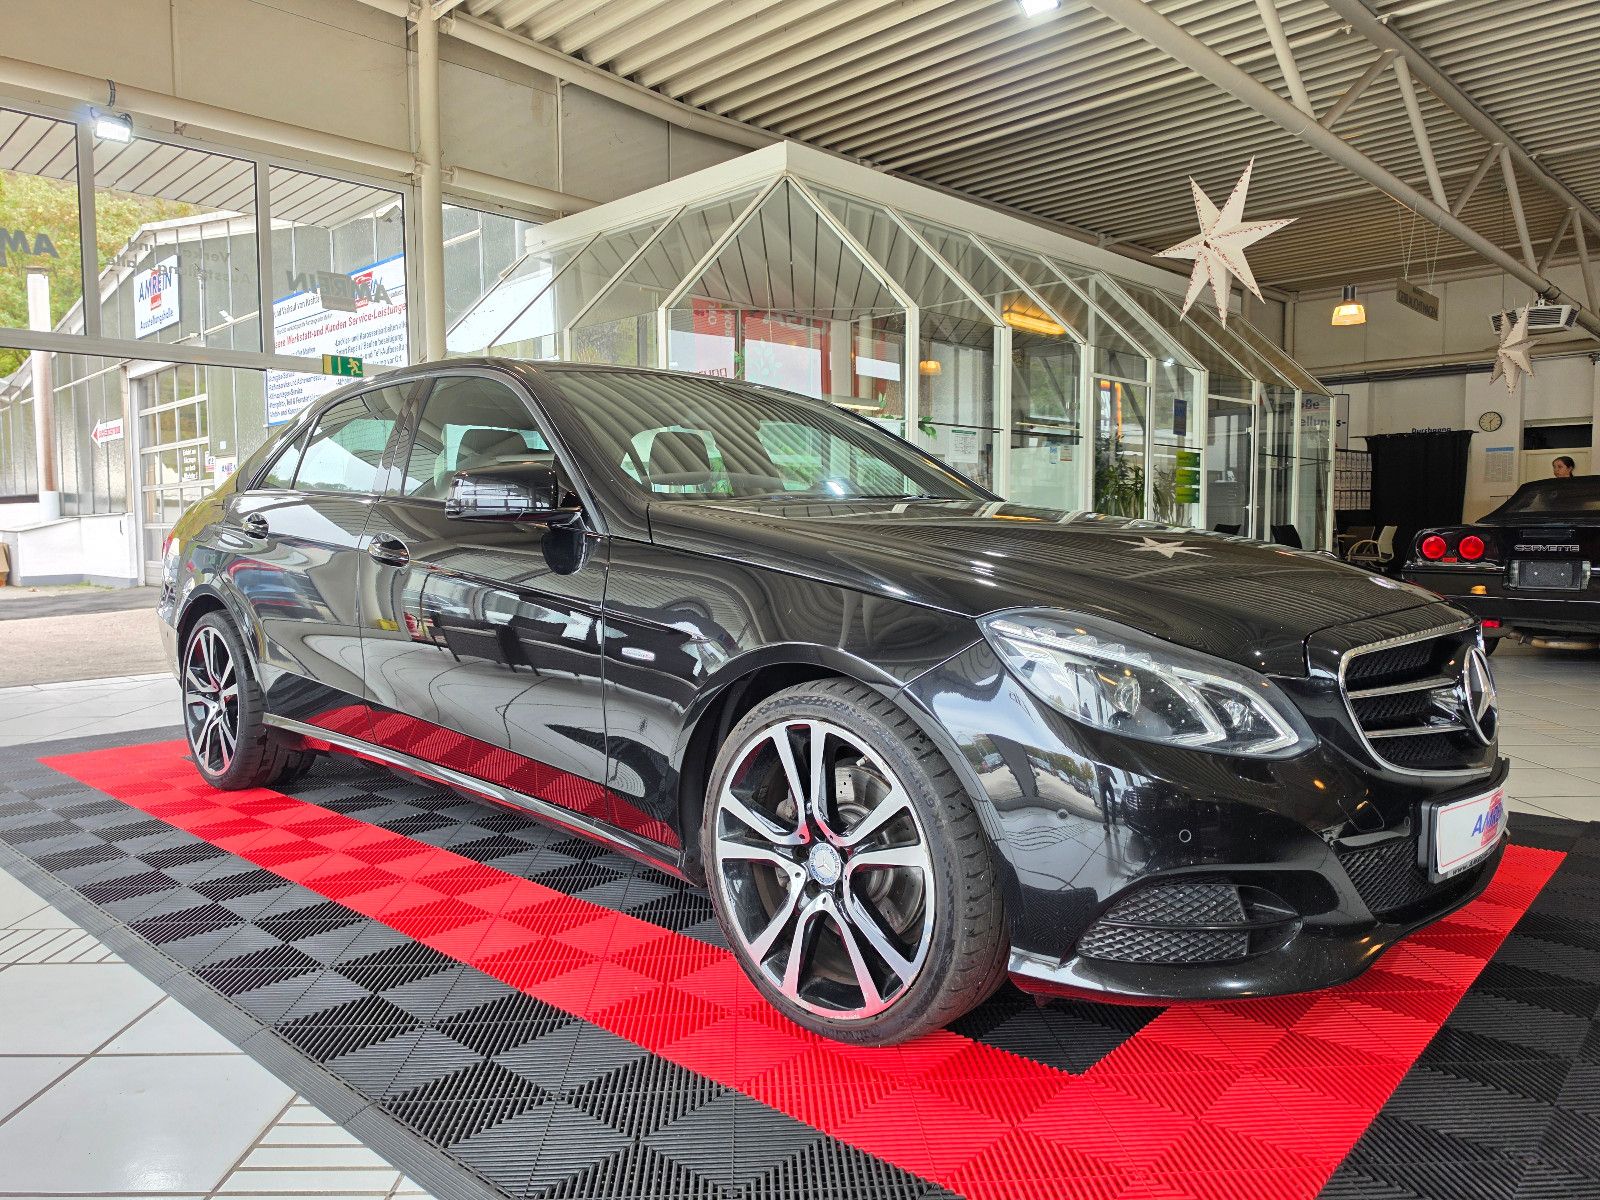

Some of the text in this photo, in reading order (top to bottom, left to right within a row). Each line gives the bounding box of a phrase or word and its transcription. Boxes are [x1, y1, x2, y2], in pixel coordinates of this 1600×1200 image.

[138, 271, 172, 302] AMREIN
[139, 308, 174, 330] Ausstellungshalle
[1514, 544, 1580, 552] CORVETTE
